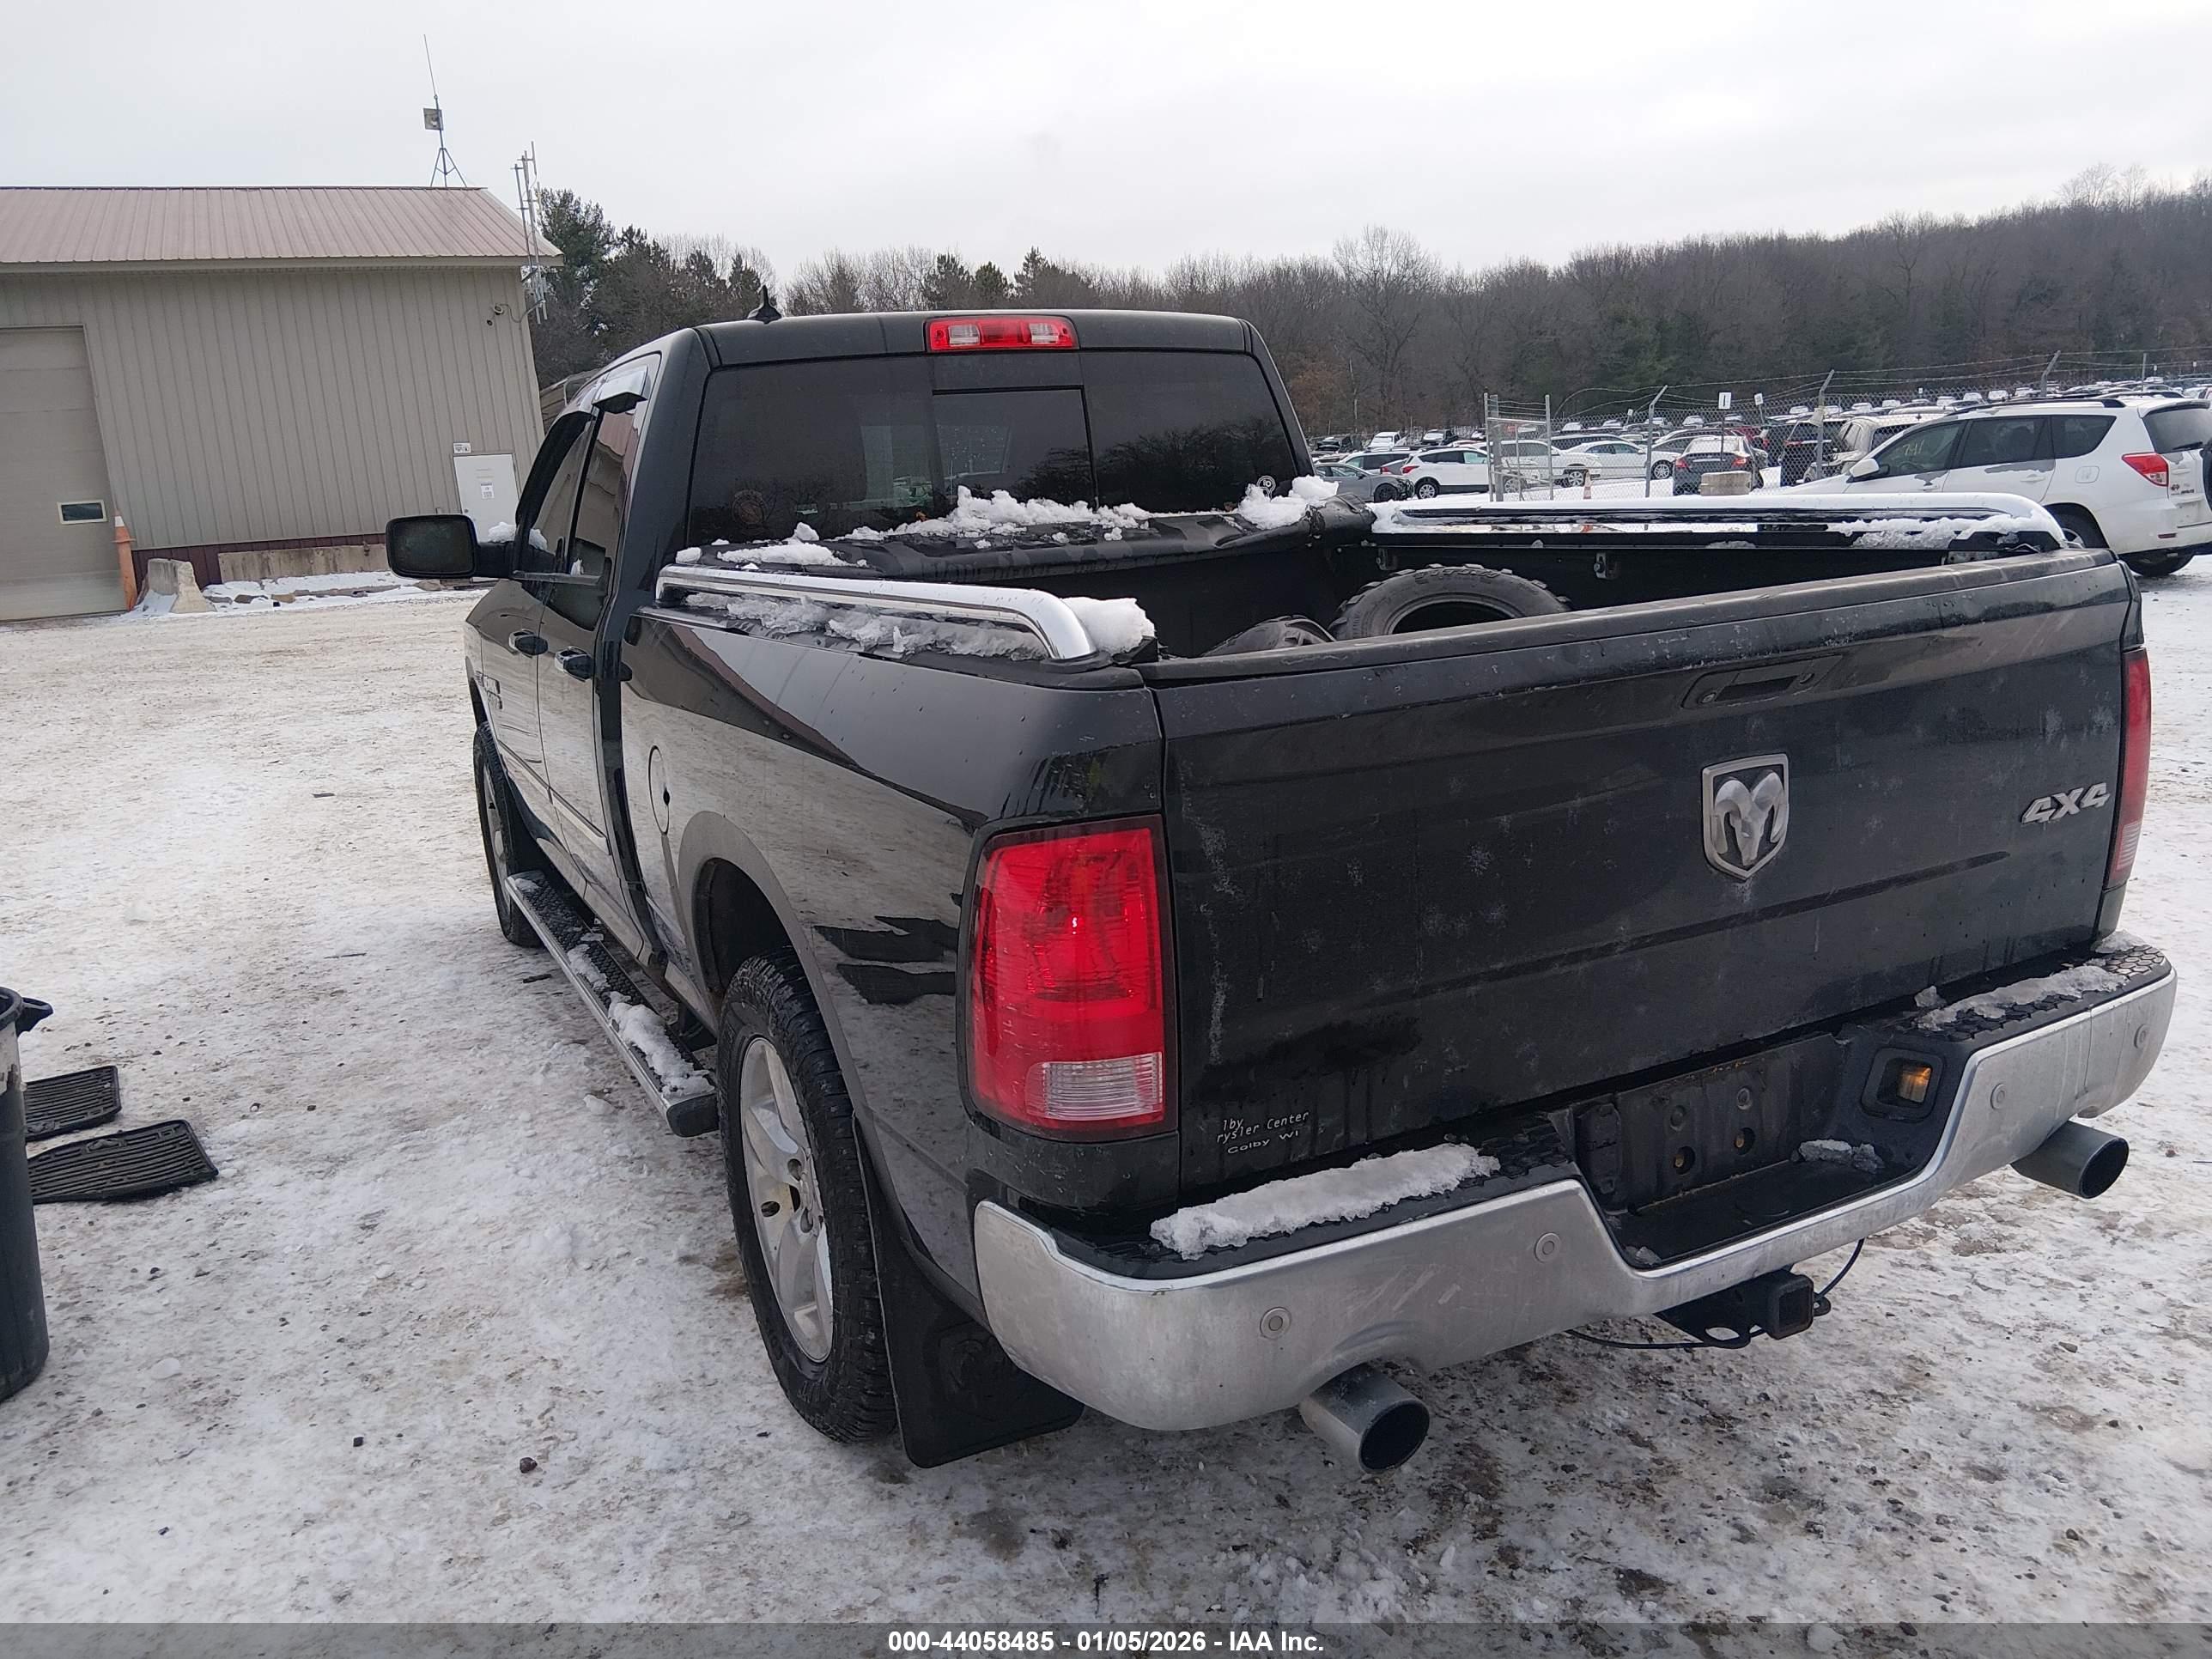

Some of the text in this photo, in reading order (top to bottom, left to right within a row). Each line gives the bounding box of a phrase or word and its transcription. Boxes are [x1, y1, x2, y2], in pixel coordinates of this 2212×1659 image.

[1267, 1111, 1310, 1129] Center
[1227, 1130, 1298, 1154] Colby WI
